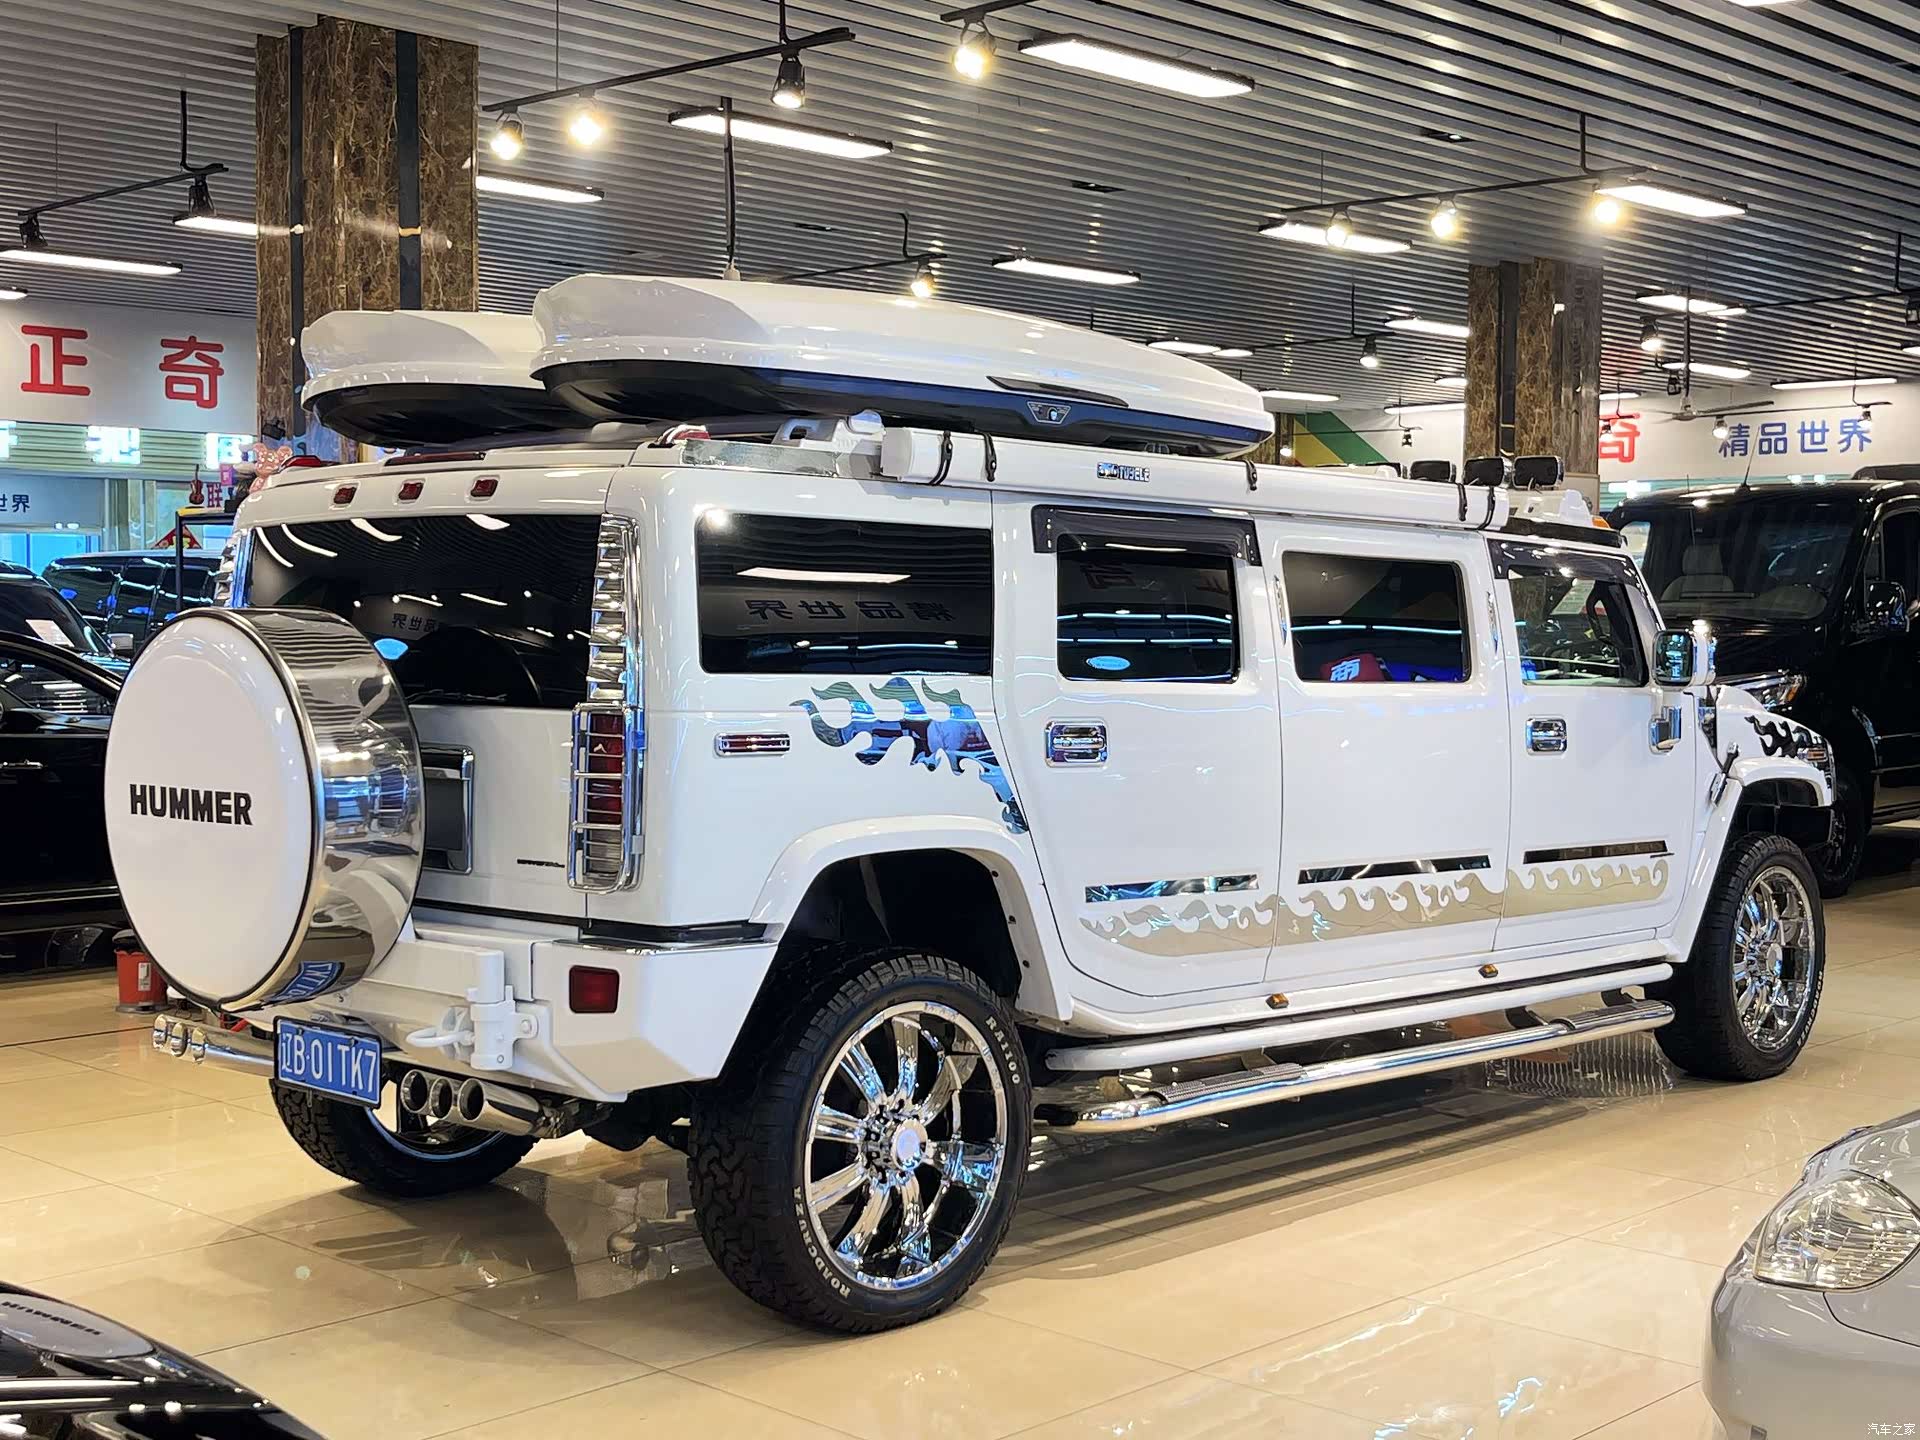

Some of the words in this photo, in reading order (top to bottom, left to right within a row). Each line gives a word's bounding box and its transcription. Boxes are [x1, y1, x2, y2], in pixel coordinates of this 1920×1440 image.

[1718, 418, 1873, 458] 精品世界
[129, 783, 253, 826] HUMMER
